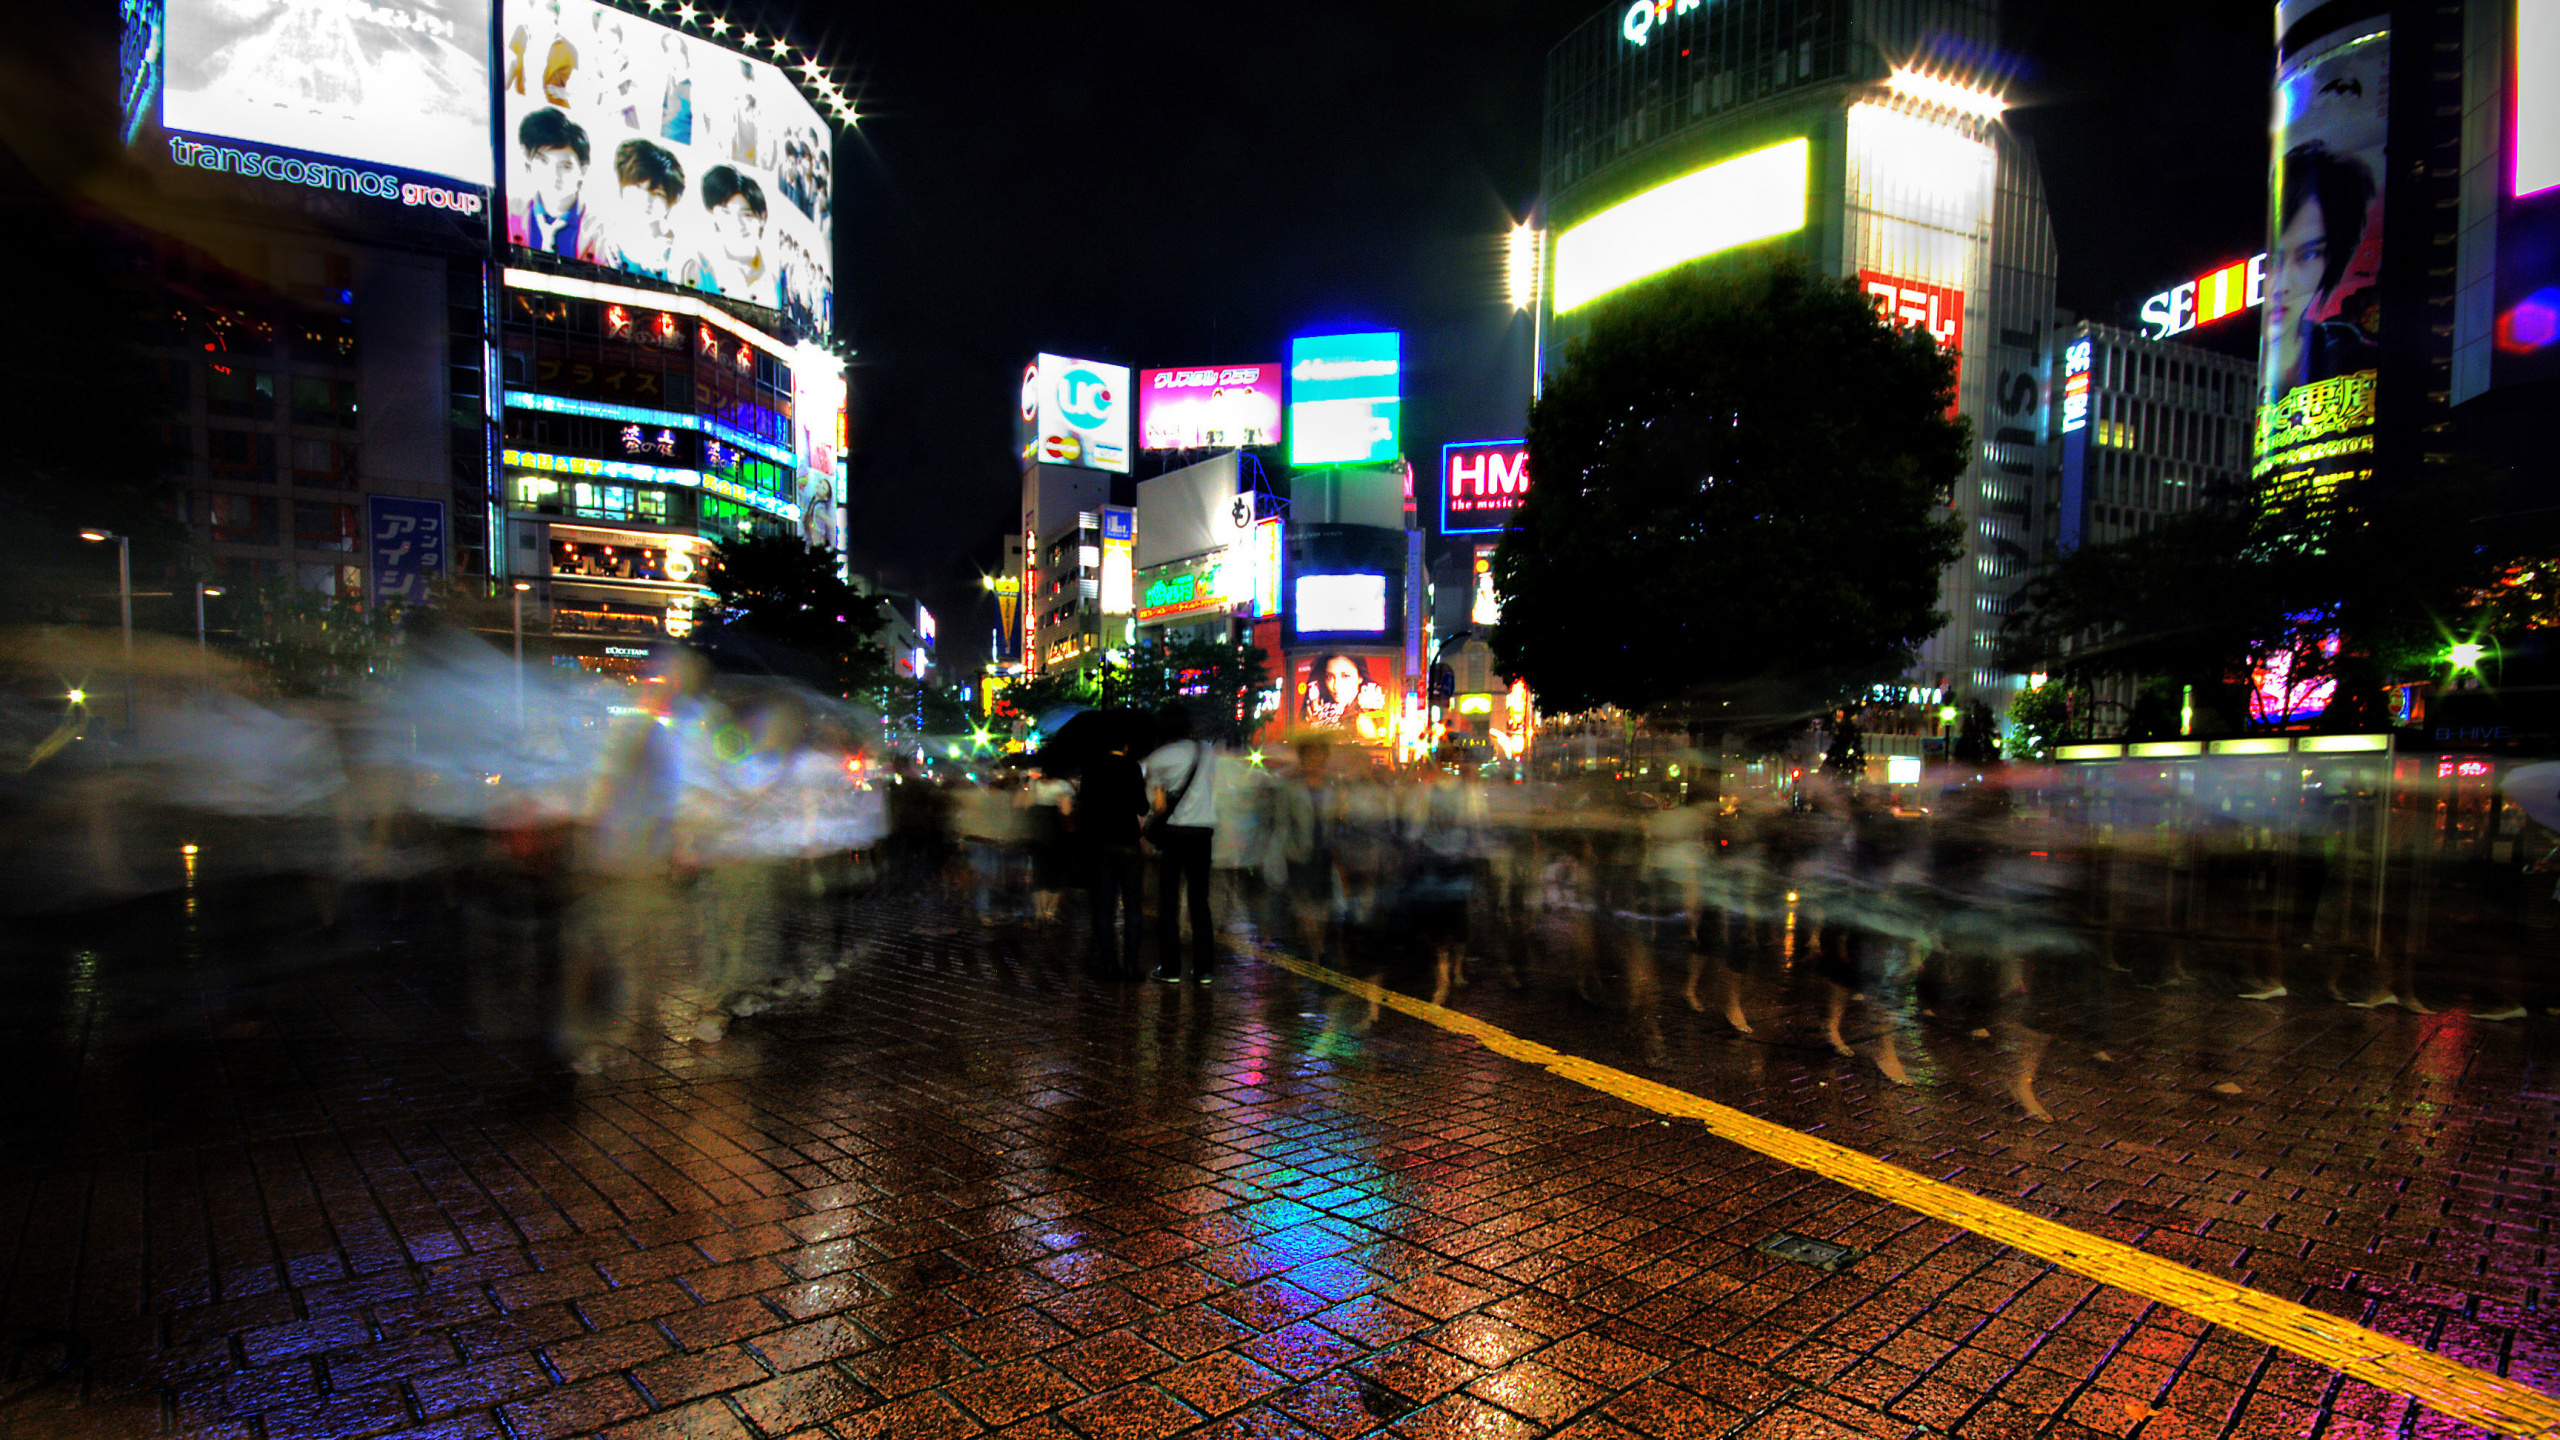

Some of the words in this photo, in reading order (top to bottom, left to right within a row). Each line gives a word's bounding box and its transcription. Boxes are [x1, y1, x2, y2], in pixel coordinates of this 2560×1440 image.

[169, 136, 399, 199] transcosmos
[401, 183, 482, 215] group
[538, 358, 658, 395] プライス
[2062, 341, 2091, 433] SEIBU
[1451, 498, 1473, 512] the
[1476, 496, 1514, 510] music
